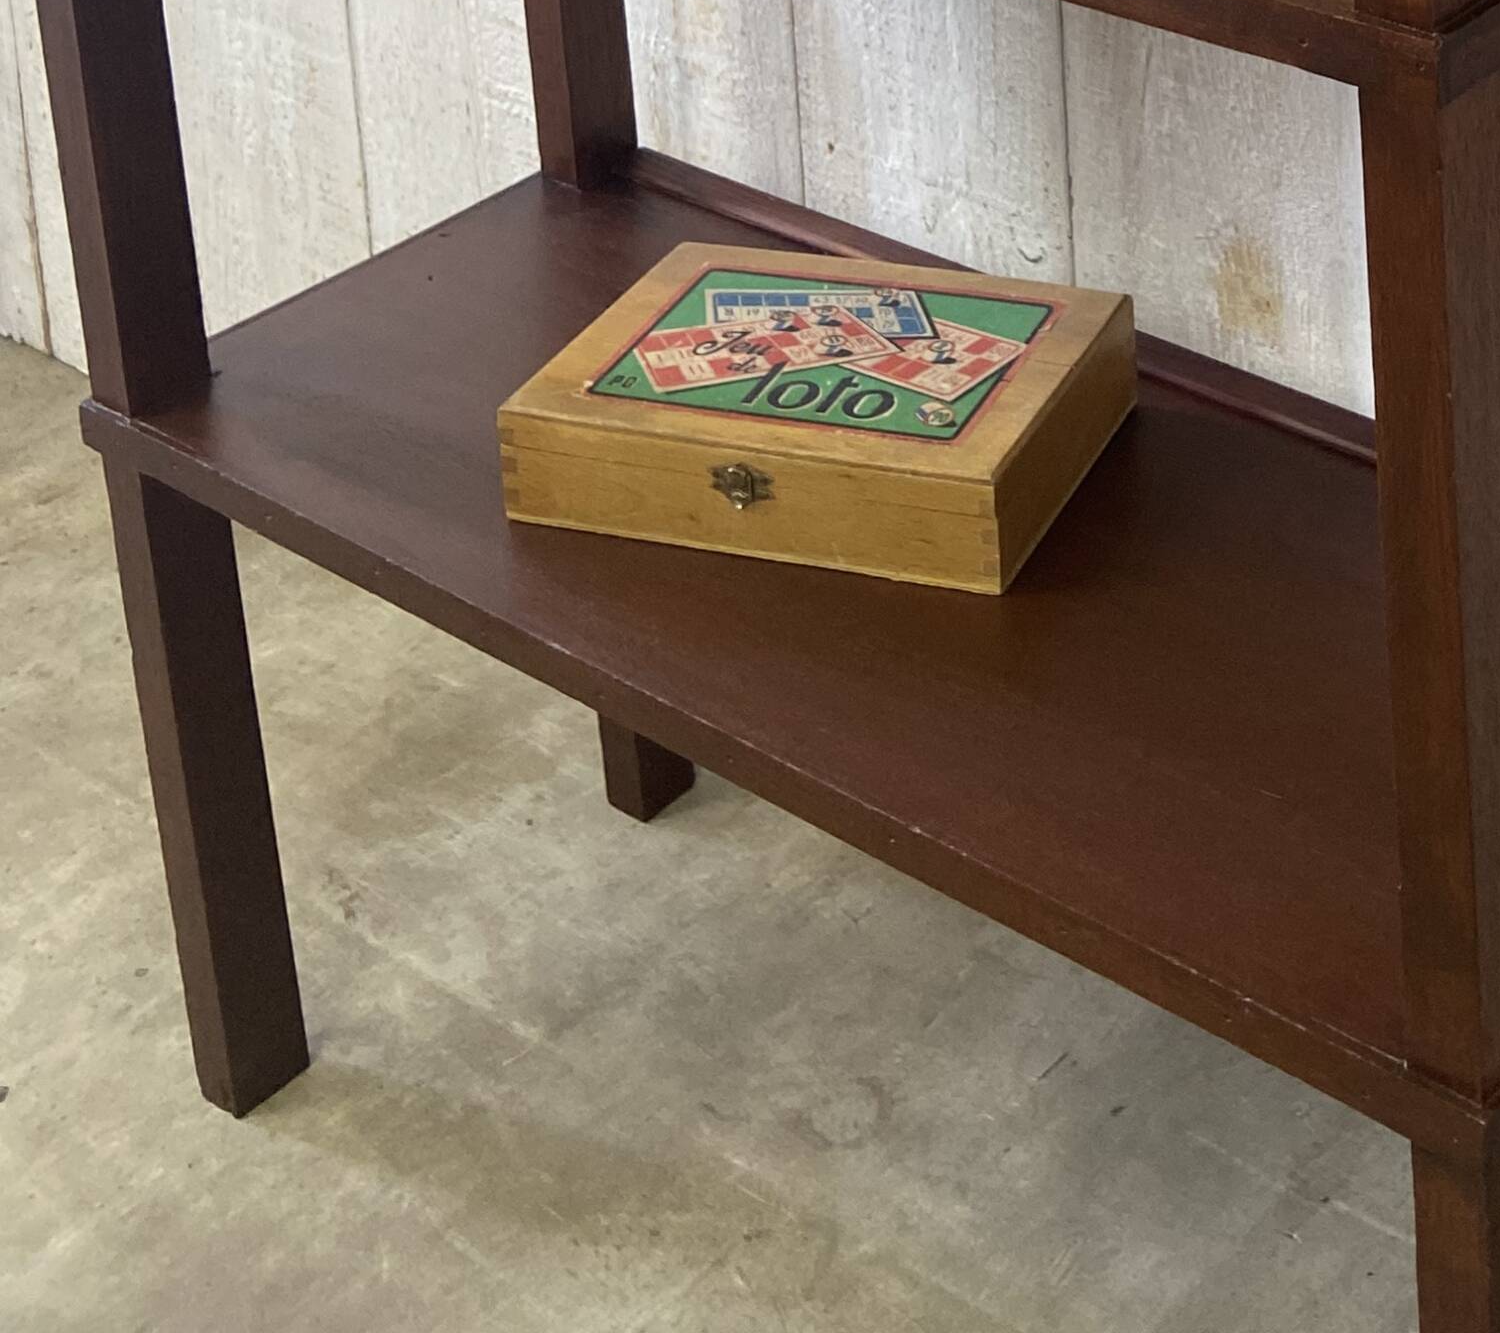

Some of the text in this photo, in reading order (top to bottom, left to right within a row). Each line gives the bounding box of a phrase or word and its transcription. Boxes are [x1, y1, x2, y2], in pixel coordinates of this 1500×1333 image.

[693, 330, 774, 357] Jeu
[727, 356, 759, 374] de
[741, 361, 895, 419] loto
